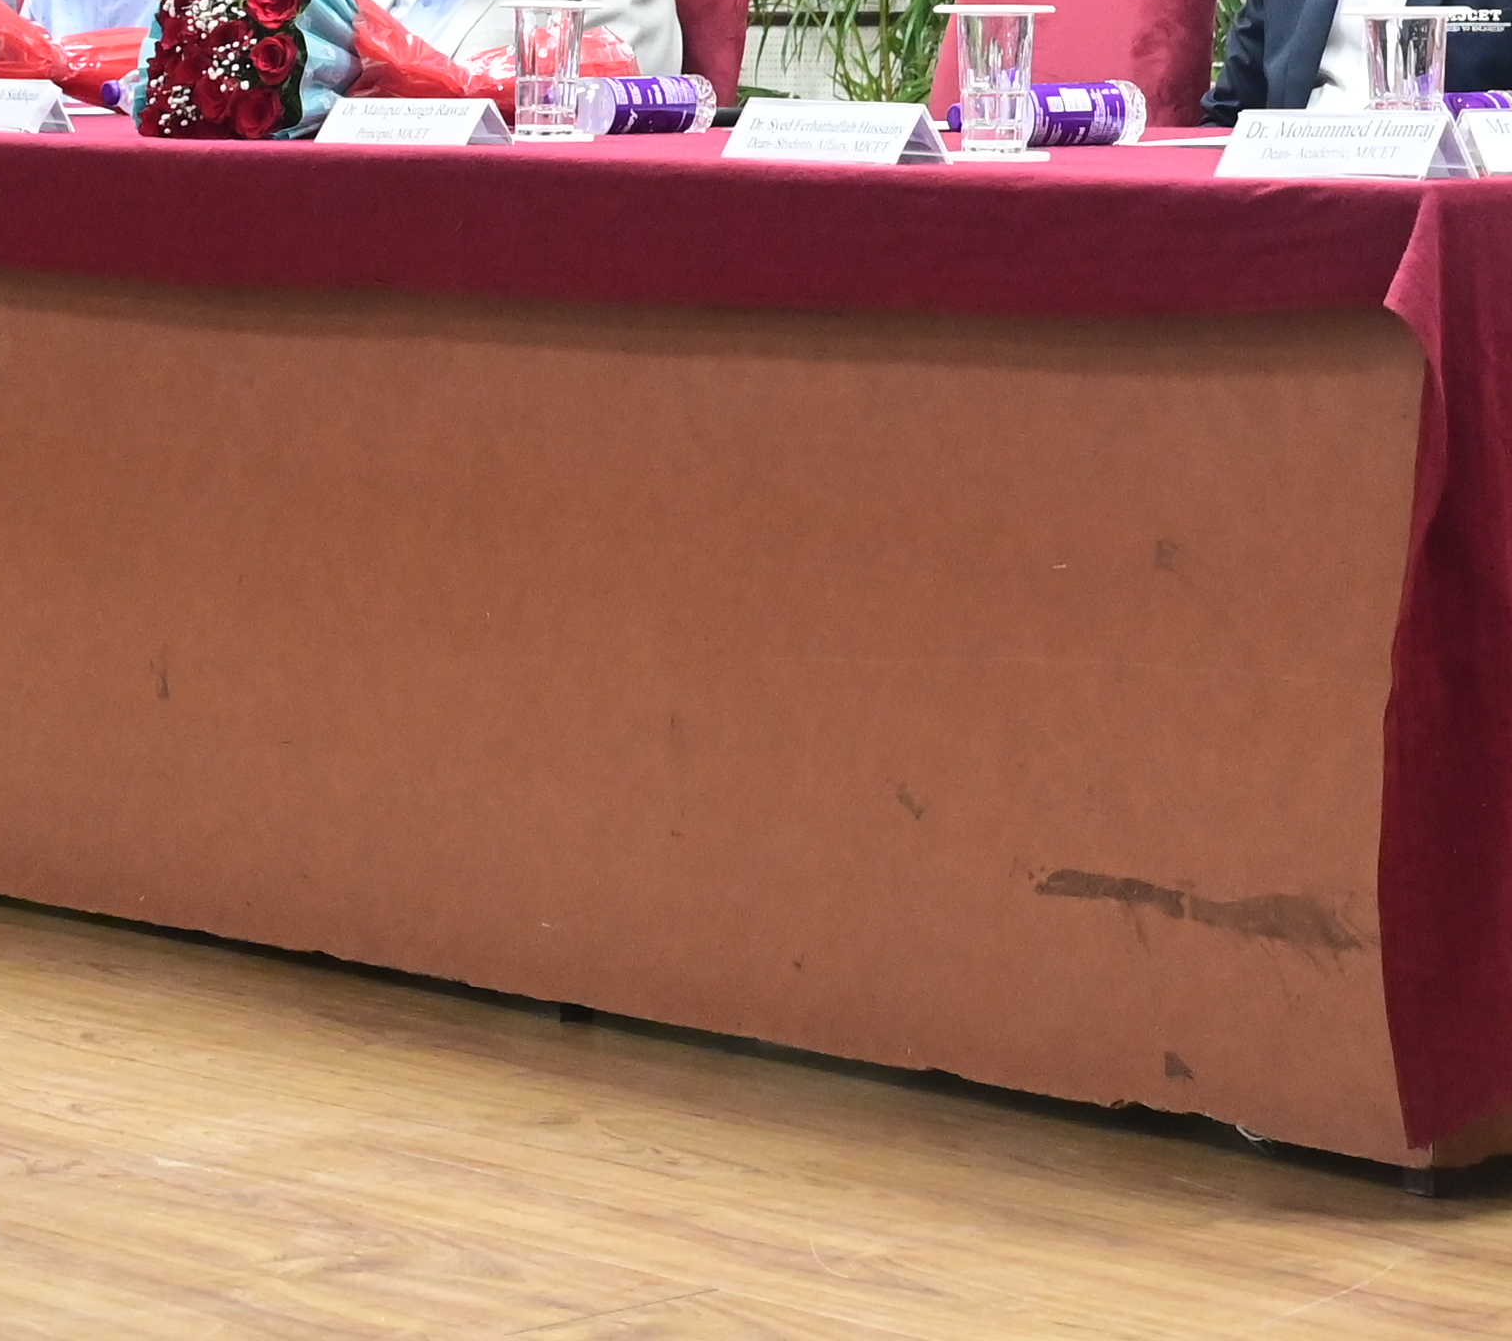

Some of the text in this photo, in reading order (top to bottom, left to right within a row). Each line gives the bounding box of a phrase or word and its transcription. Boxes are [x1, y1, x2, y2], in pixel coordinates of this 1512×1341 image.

[341, 103, 357, 116] Dr.
[406, 103, 434, 120] Singh
[436, 104, 471, 116] Rawat
[748, 116, 765, 132] Dr.
[766, 118, 794, 133] Syed
[1245, 118, 1439, 143] Dr. Mohammed Hamraj
[774, 137, 814, 150] Students
[852, 140, 891, 154] MJCET
[1260, 145, 1400, 161] Dean- Academic, MJCET
